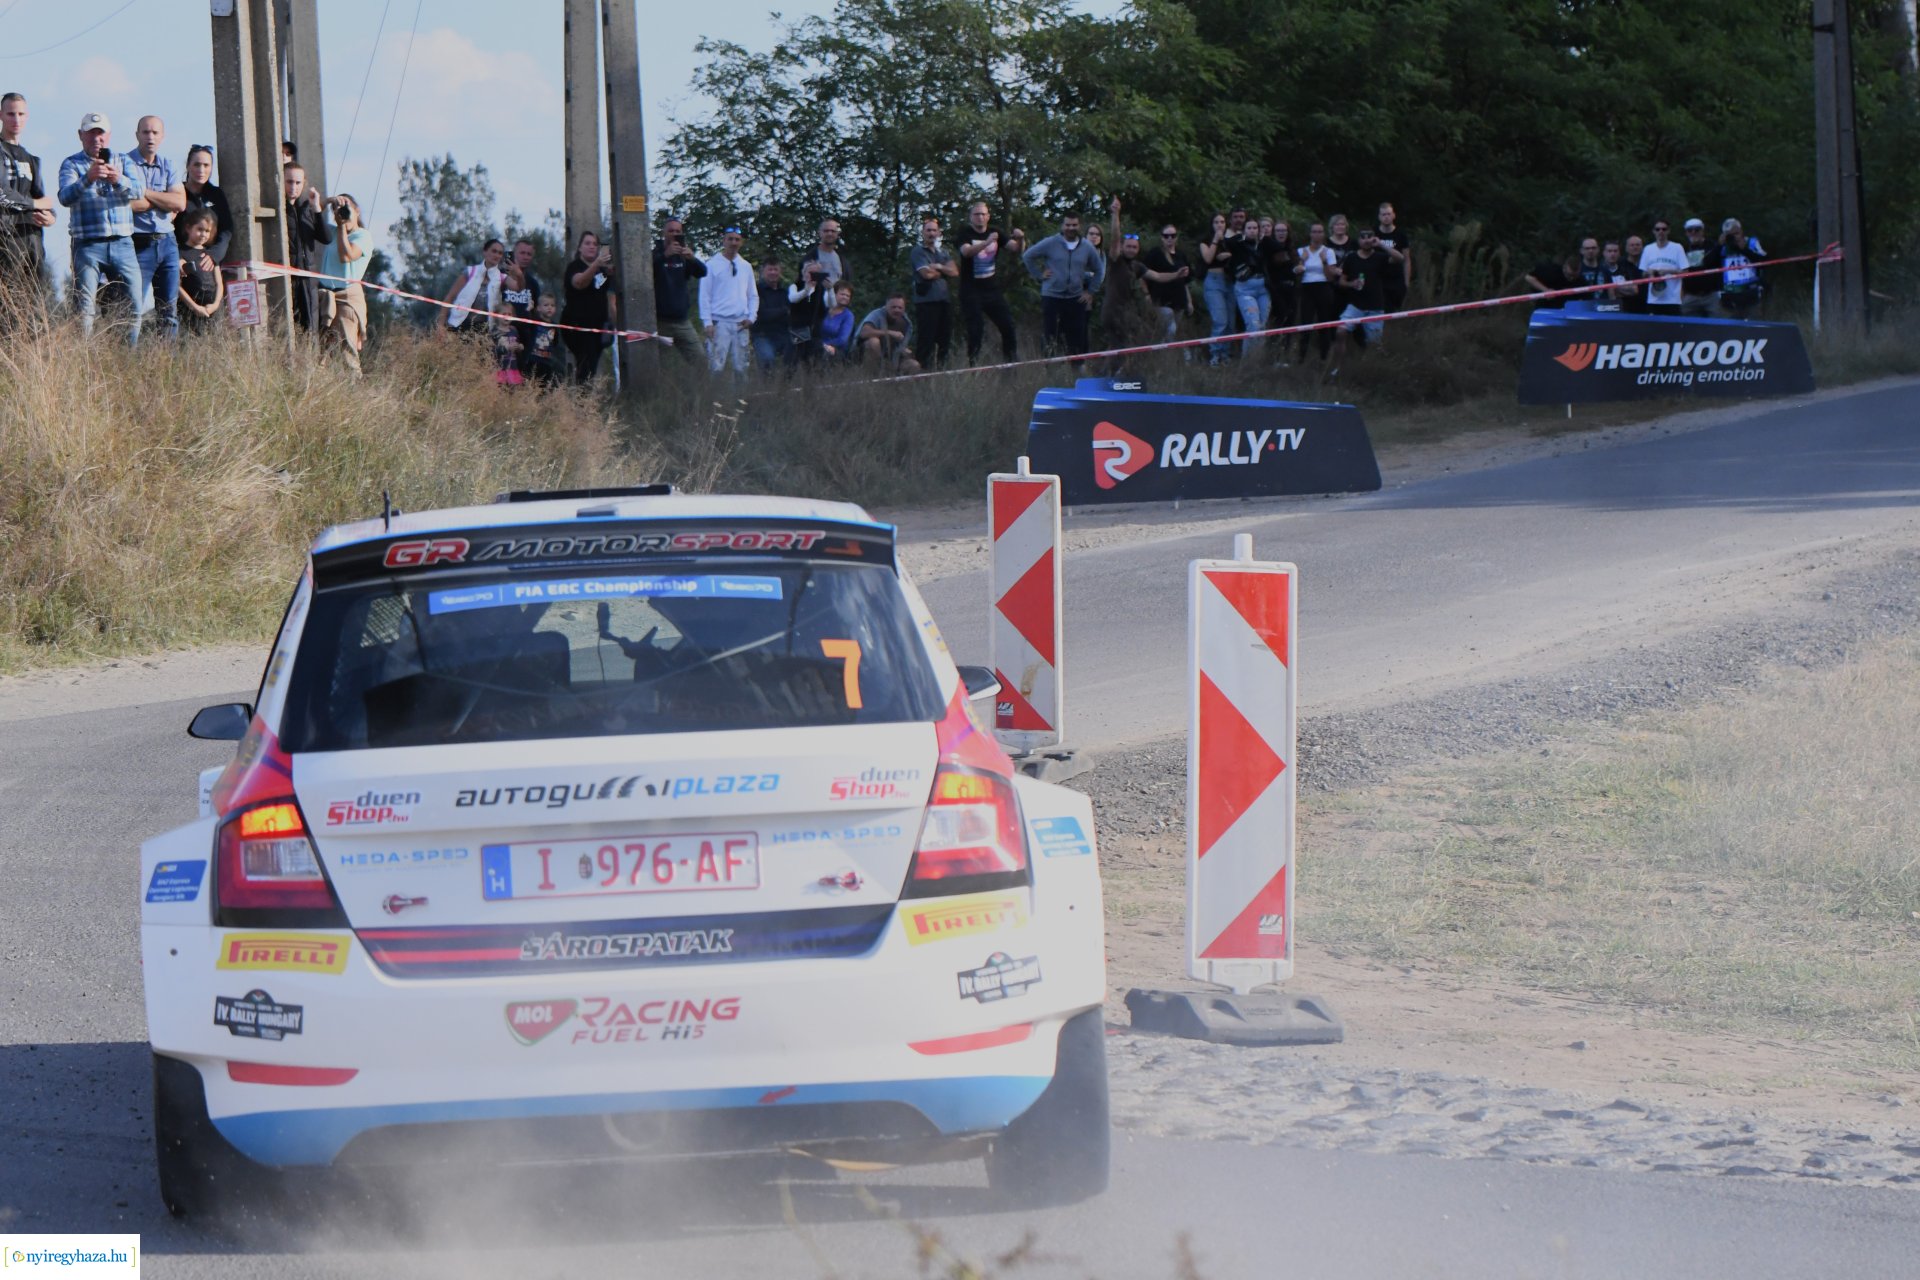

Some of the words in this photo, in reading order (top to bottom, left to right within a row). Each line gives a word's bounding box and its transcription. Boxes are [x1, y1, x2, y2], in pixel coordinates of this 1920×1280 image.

[1113, 381, 1142, 391] ERC
[1637, 369, 1694, 387] driving
[1698, 368, 1765, 383] emotion
[383, 537, 470, 568] GR
[473, 530, 826, 561] MOTORSPORT
[515, 585, 543, 598] FIA
[547, 582, 580, 595] ERC
[584, 579, 697, 594] Championship
[820, 639, 863, 709] 7
[860, 766, 920, 782] duen
[356, 791, 421, 807] duen
[912, 901, 1018, 934] PIRELL
[228, 940, 338, 966] PIRELLI
[519, 929, 735, 961] SÁROSPATAK
[216, 1002, 230, 1021] IV.
[229, 1006, 258, 1025] RALLY
[257, 1010, 301, 1030] HUNGARY
[514, 1006, 553, 1024] MOL
[580, 997, 742, 1028] RACING
[571, 1028, 649, 1045] FUEL
